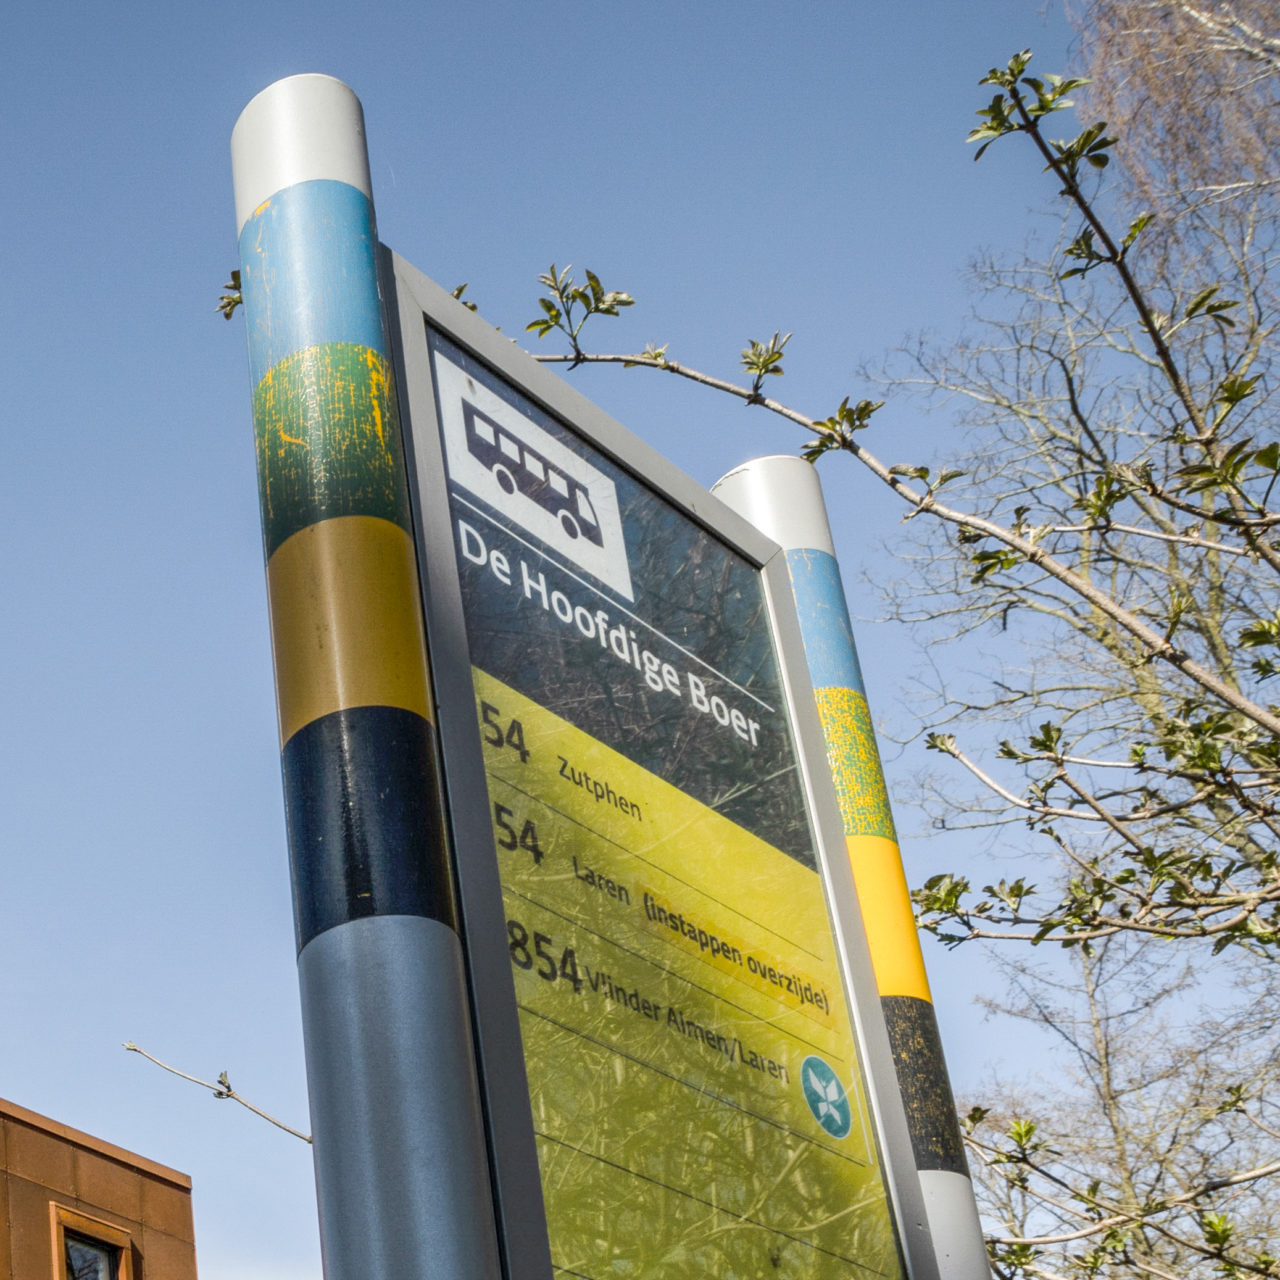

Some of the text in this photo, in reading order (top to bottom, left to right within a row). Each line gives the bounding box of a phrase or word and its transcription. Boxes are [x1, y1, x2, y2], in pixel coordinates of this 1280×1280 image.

[459, 520, 761, 747] De Hoofdige Boer
[481, 700, 643, 822] 54 Zutphen
[494, 801, 830, 1016] 54 Laren (instappen overzijde)
[505, 918, 791, 1085] 854 Vlinder Almen/Laren
